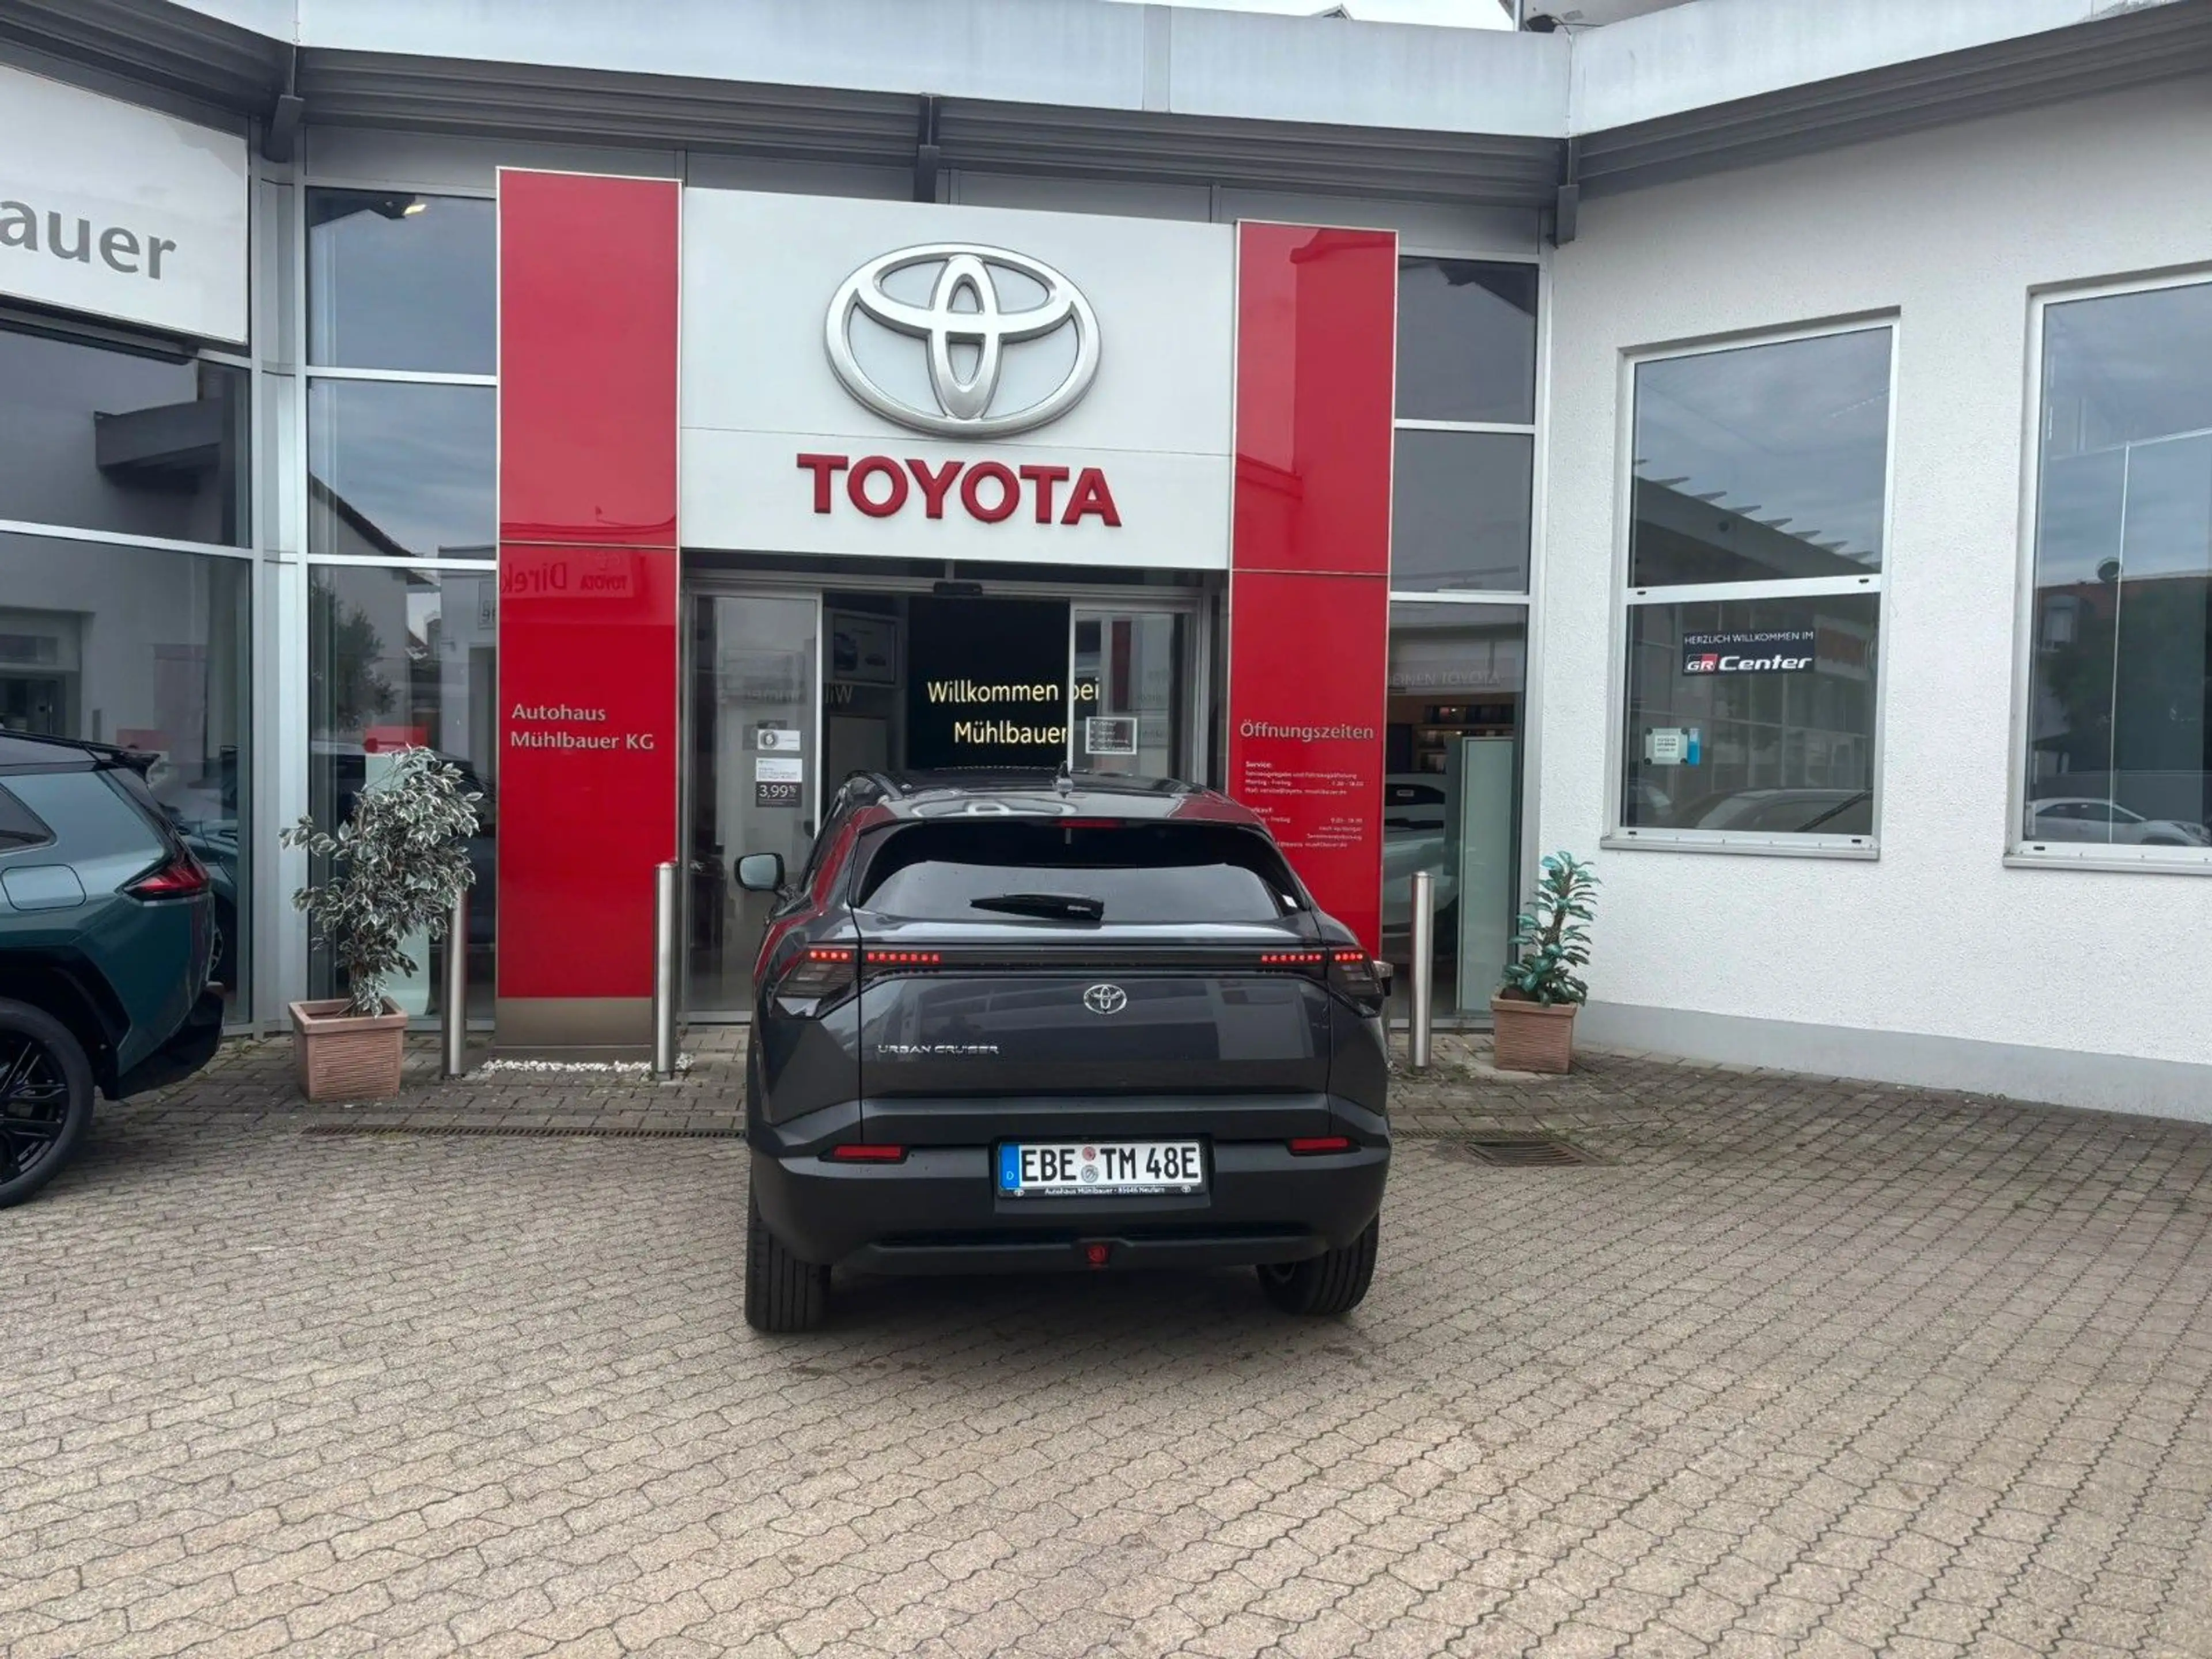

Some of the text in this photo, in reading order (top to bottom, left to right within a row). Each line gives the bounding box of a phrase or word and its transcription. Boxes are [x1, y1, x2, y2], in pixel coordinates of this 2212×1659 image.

[797, 453, 1122, 527] TOYOTA
[1685, 631, 1814, 645] HERZLICH WILLKOMMEN IM
[1687, 654, 1813, 672] GR Center
[927, 679, 1059, 703] Willkommen
[512, 703, 606, 721] Autohaus
[511, 730, 654, 749] Mühlbauer KG
[955, 721, 1067, 744] Mühlbauer
[1240, 719, 1374, 743] Öffnungszeiten
[759, 785, 789, 799] 3,99
[878, 1044, 999, 1055] URBAN CRUISER
[1021, 1147, 1199, 1182] EBE TM 48E
[1006, 1171, 1014, 1180] D
